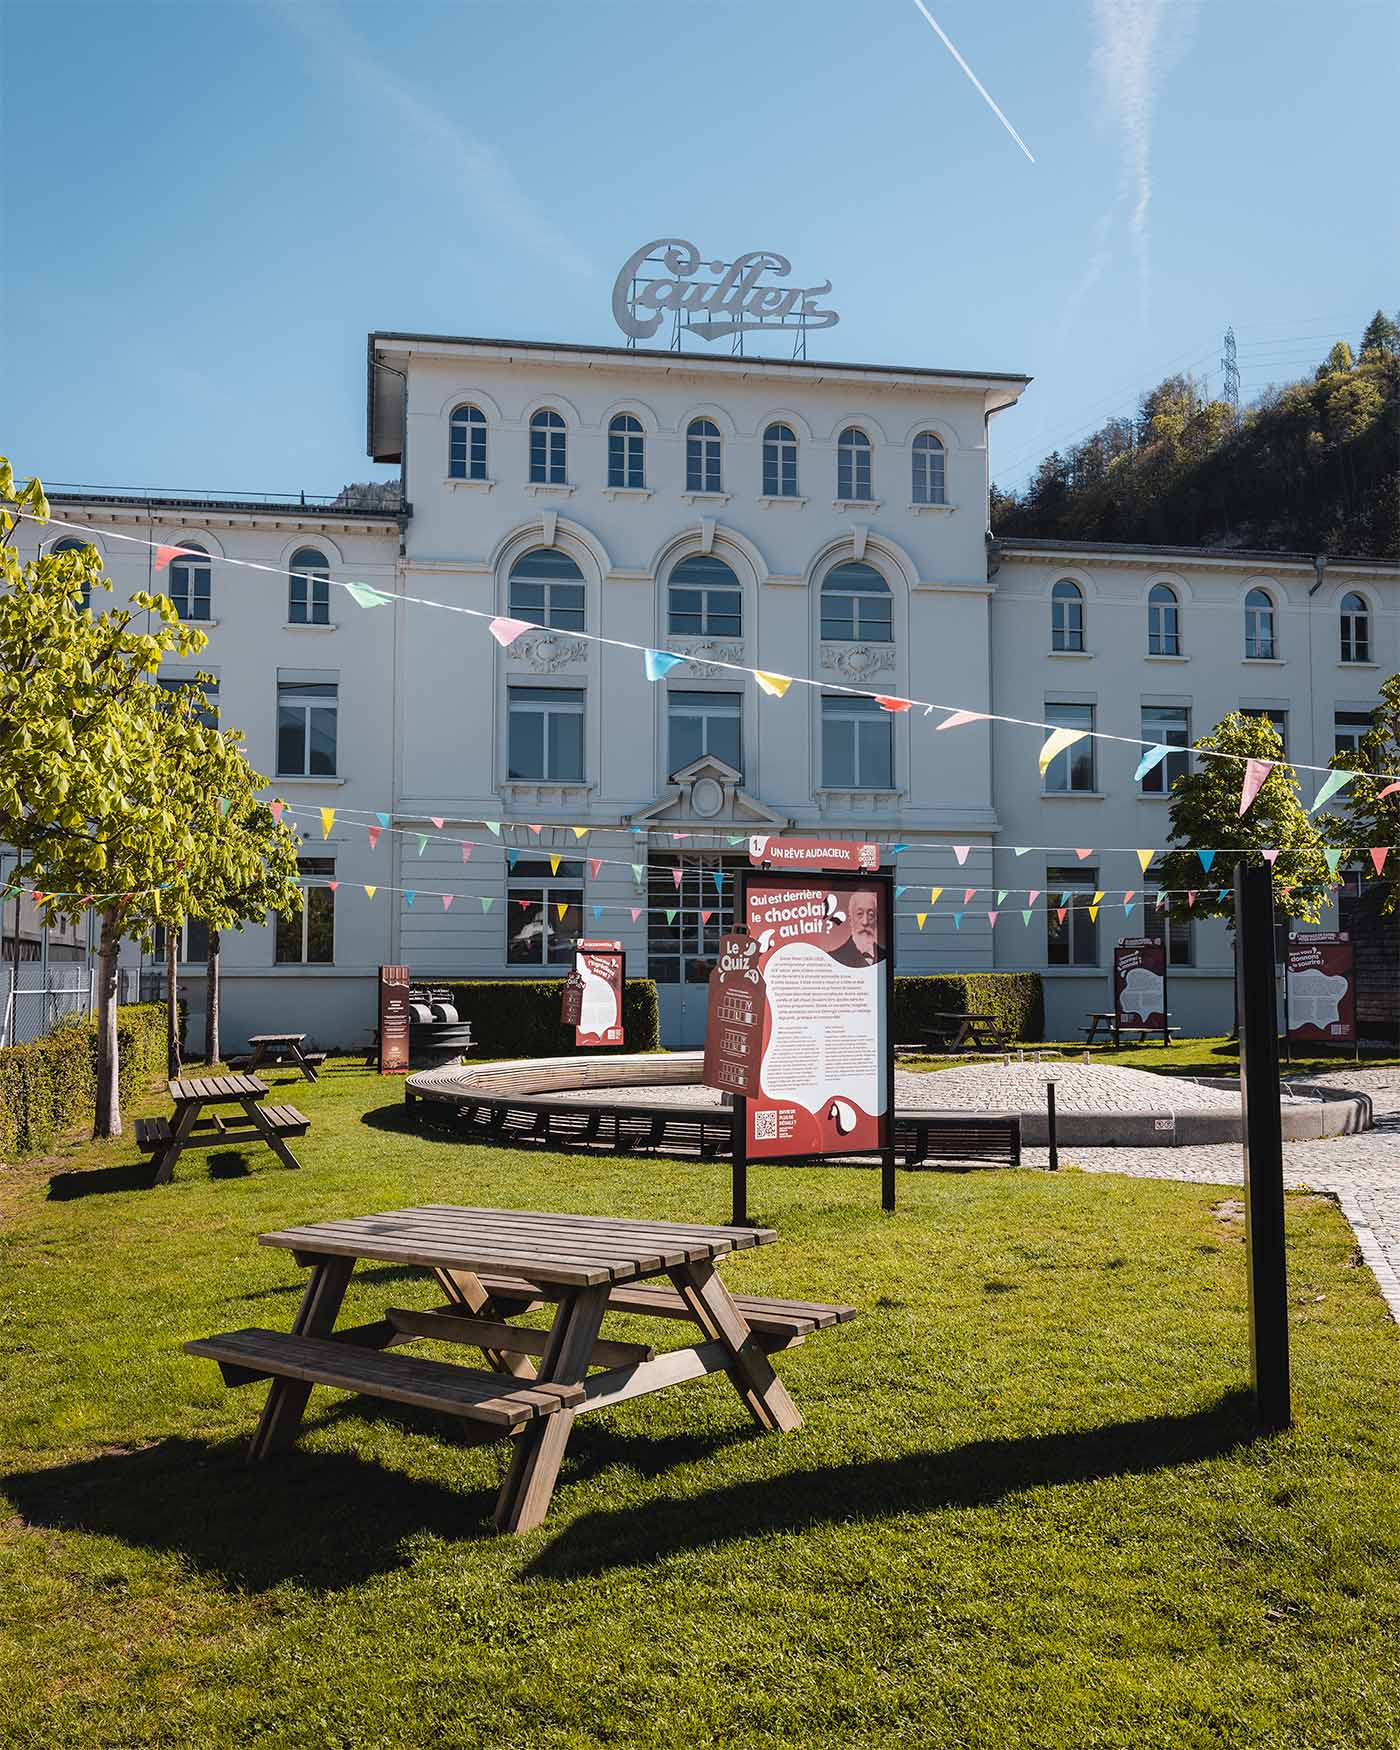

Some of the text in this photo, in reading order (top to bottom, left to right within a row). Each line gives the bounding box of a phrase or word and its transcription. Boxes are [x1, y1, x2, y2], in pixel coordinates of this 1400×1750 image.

[612, 238, 840, 342] Cailler
[752, 839, 762, 852] 1.
[770, 846, 850, 860] UN RÊVE AUDACIEUX
[750, 889, 823, 906] Qui est derrière
[751, 902, 826, 923] le chocolat
[779, 919, 833, 939] au lait ?
[726, 941, 739, 954] Le
[721, 954, 750, 972] Quiz
[1291, 953, 1320, 962] donnons
[1298, 959, 1321, 968] sourire
